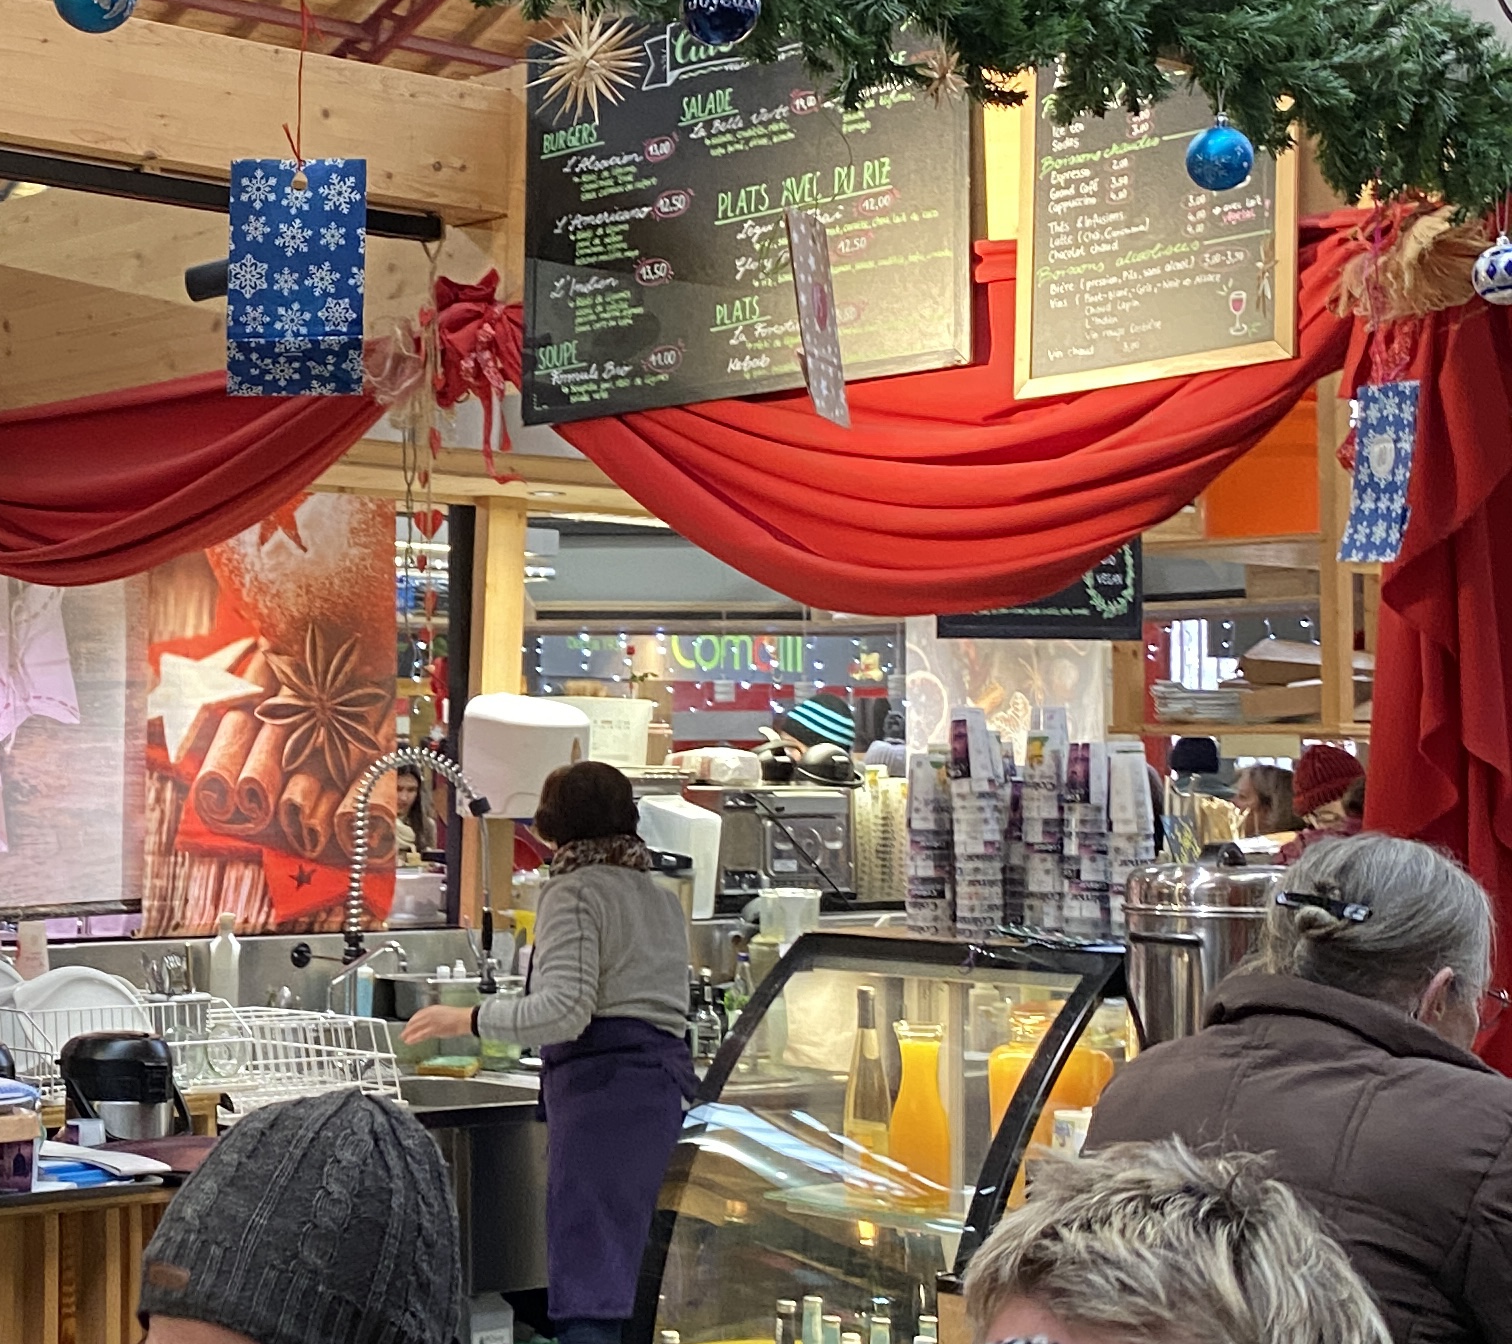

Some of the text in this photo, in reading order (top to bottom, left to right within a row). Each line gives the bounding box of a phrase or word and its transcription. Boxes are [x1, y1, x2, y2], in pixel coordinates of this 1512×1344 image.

[681, 87, 734, 123] SALADE
[542, 121, 599, 154] BURGERS
[717, 183, 770, 219] PLATS
[833, 164, 856, 195] DU
[862, 156, 891, 189] RIZ
[715, 295, 760, 325] PLATS
[537, 339, 579, 370] SOUPE
